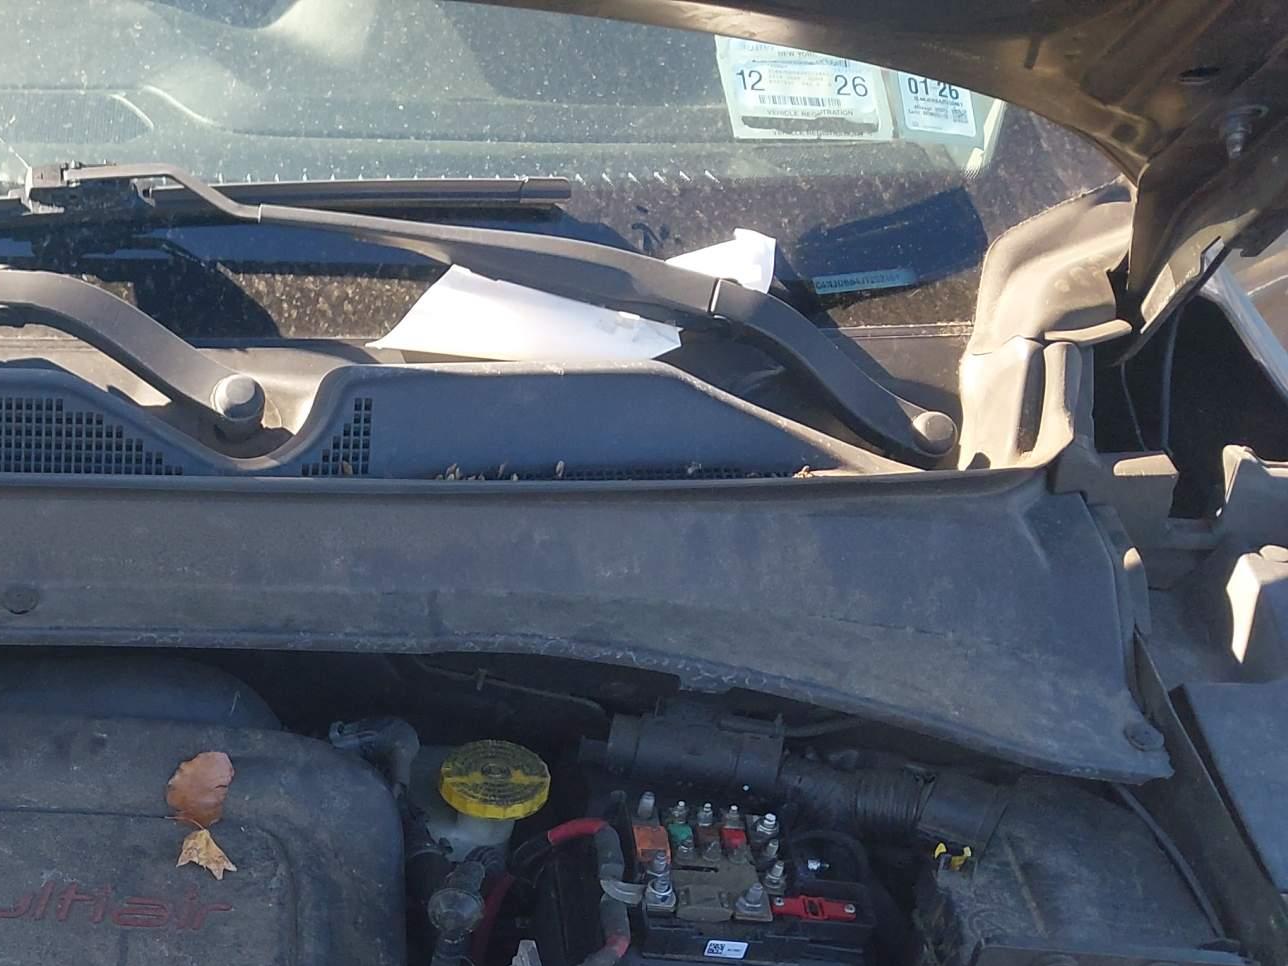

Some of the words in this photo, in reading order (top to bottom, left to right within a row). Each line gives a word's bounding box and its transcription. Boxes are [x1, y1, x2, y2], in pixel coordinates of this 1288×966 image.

[735, 68, 766, 92] 12
[833, 73, 869, 98] 26
[907, 77, 929, 95] 01
[800, 109, 854, 117] REGTRATION
